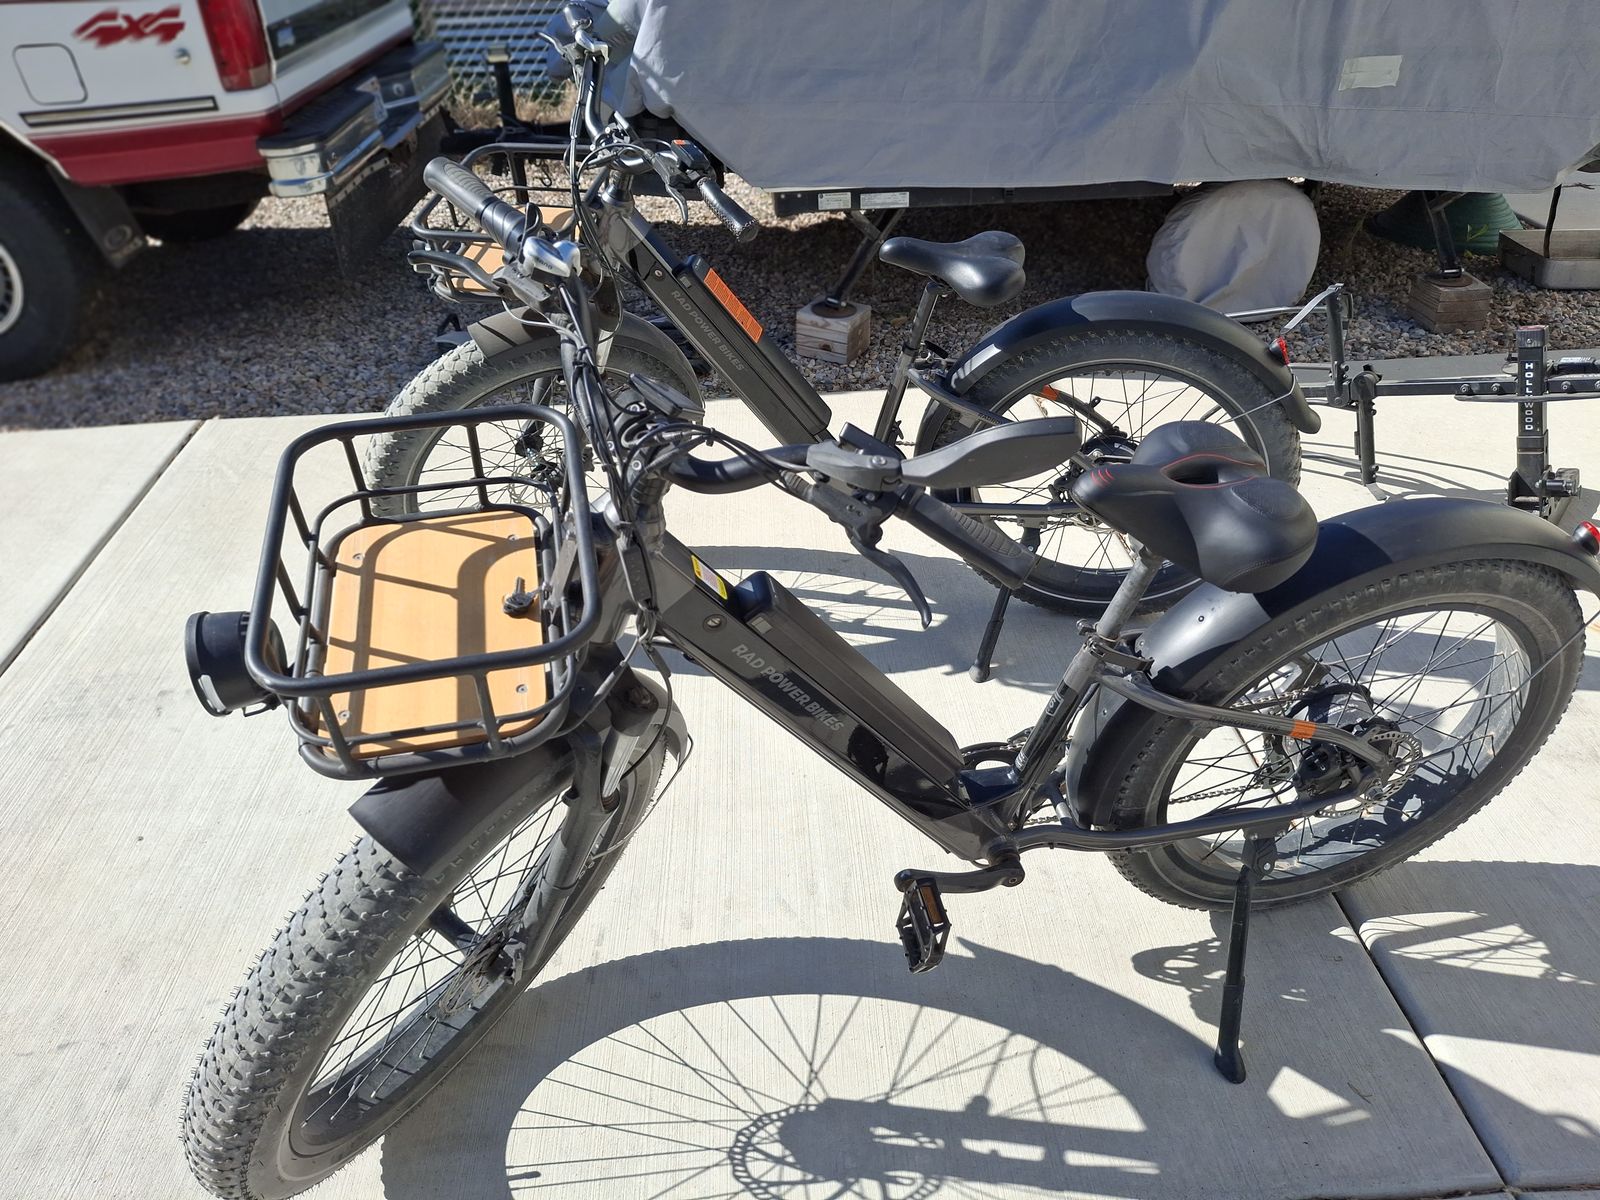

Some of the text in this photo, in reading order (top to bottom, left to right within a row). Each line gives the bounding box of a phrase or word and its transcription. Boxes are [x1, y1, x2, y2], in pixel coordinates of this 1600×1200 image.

[671, 290, 745, 371] RAD POWER BIKES
[731, 643, 845, 731] RAD POWER BIKES
